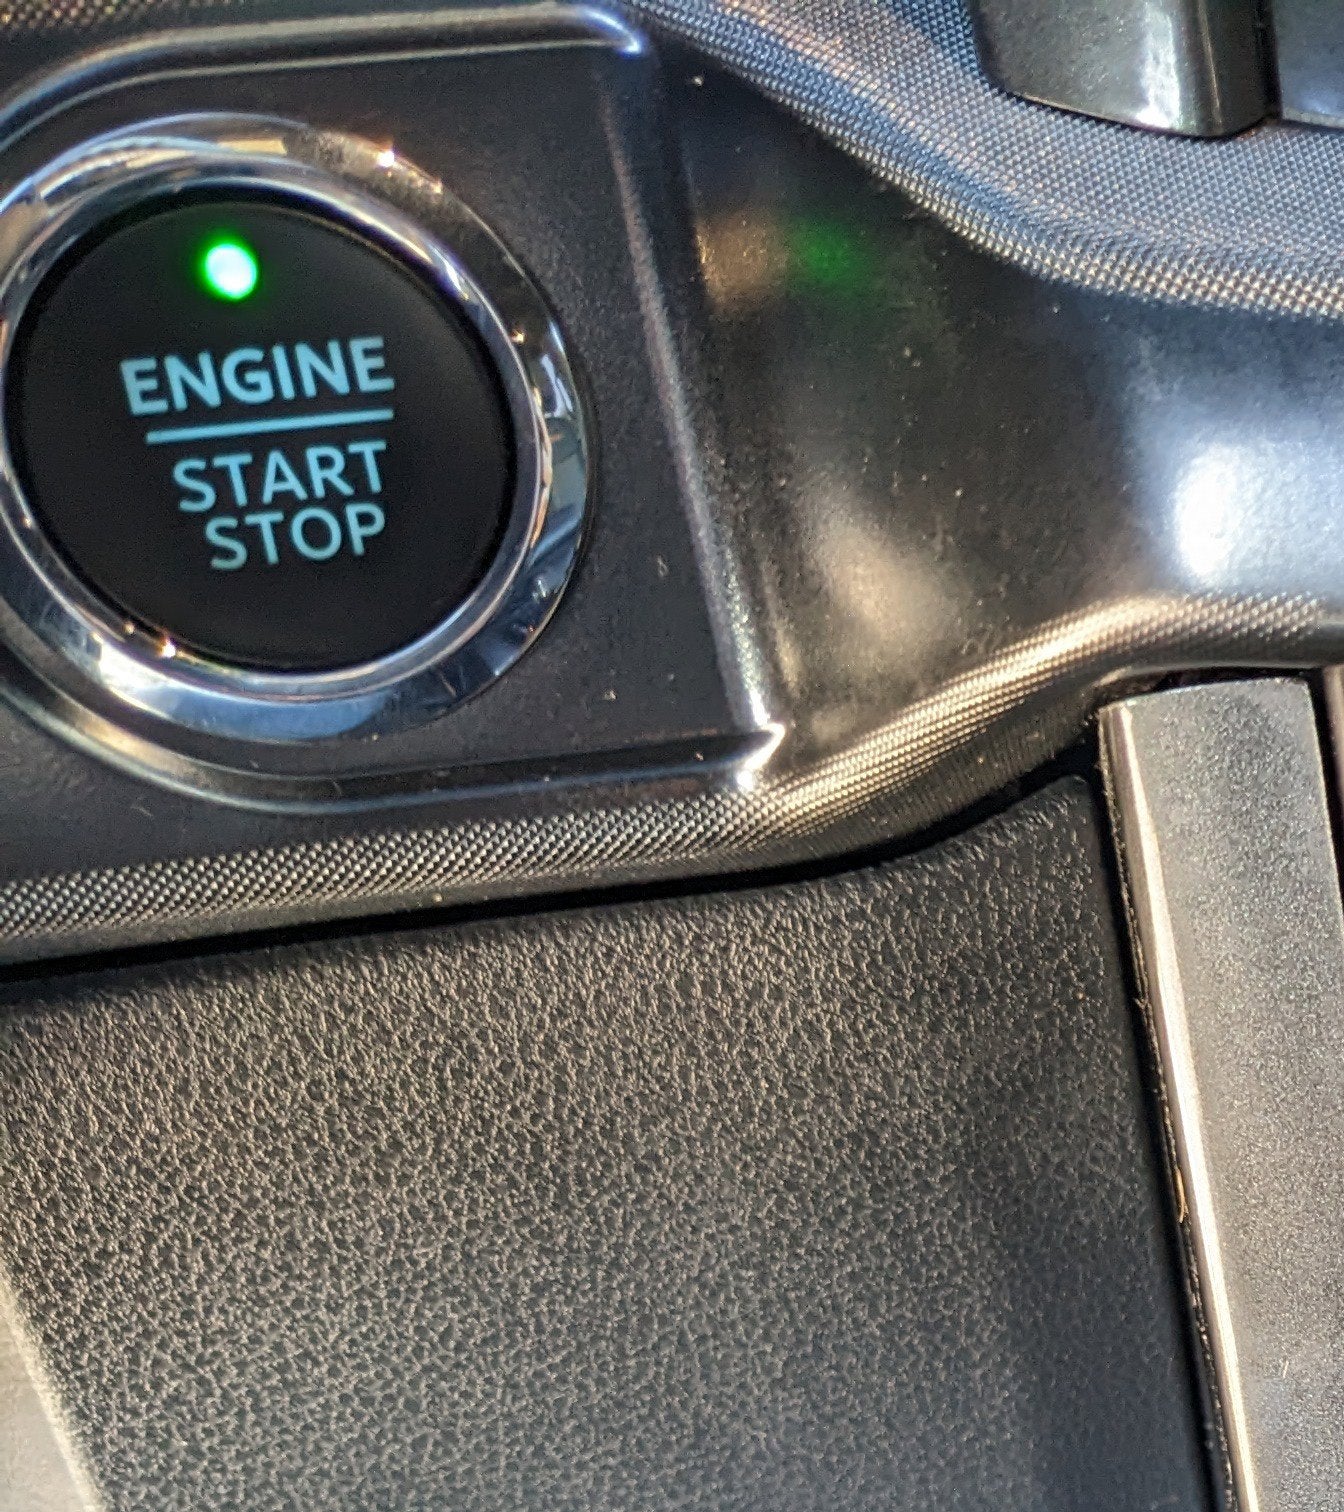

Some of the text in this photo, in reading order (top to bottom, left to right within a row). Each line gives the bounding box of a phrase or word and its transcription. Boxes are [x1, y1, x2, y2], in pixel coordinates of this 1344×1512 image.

[120, 335, 395, 417] ENGINE
[172, 440, 387, 513] START
[205, 502, 386, 571] STOP
